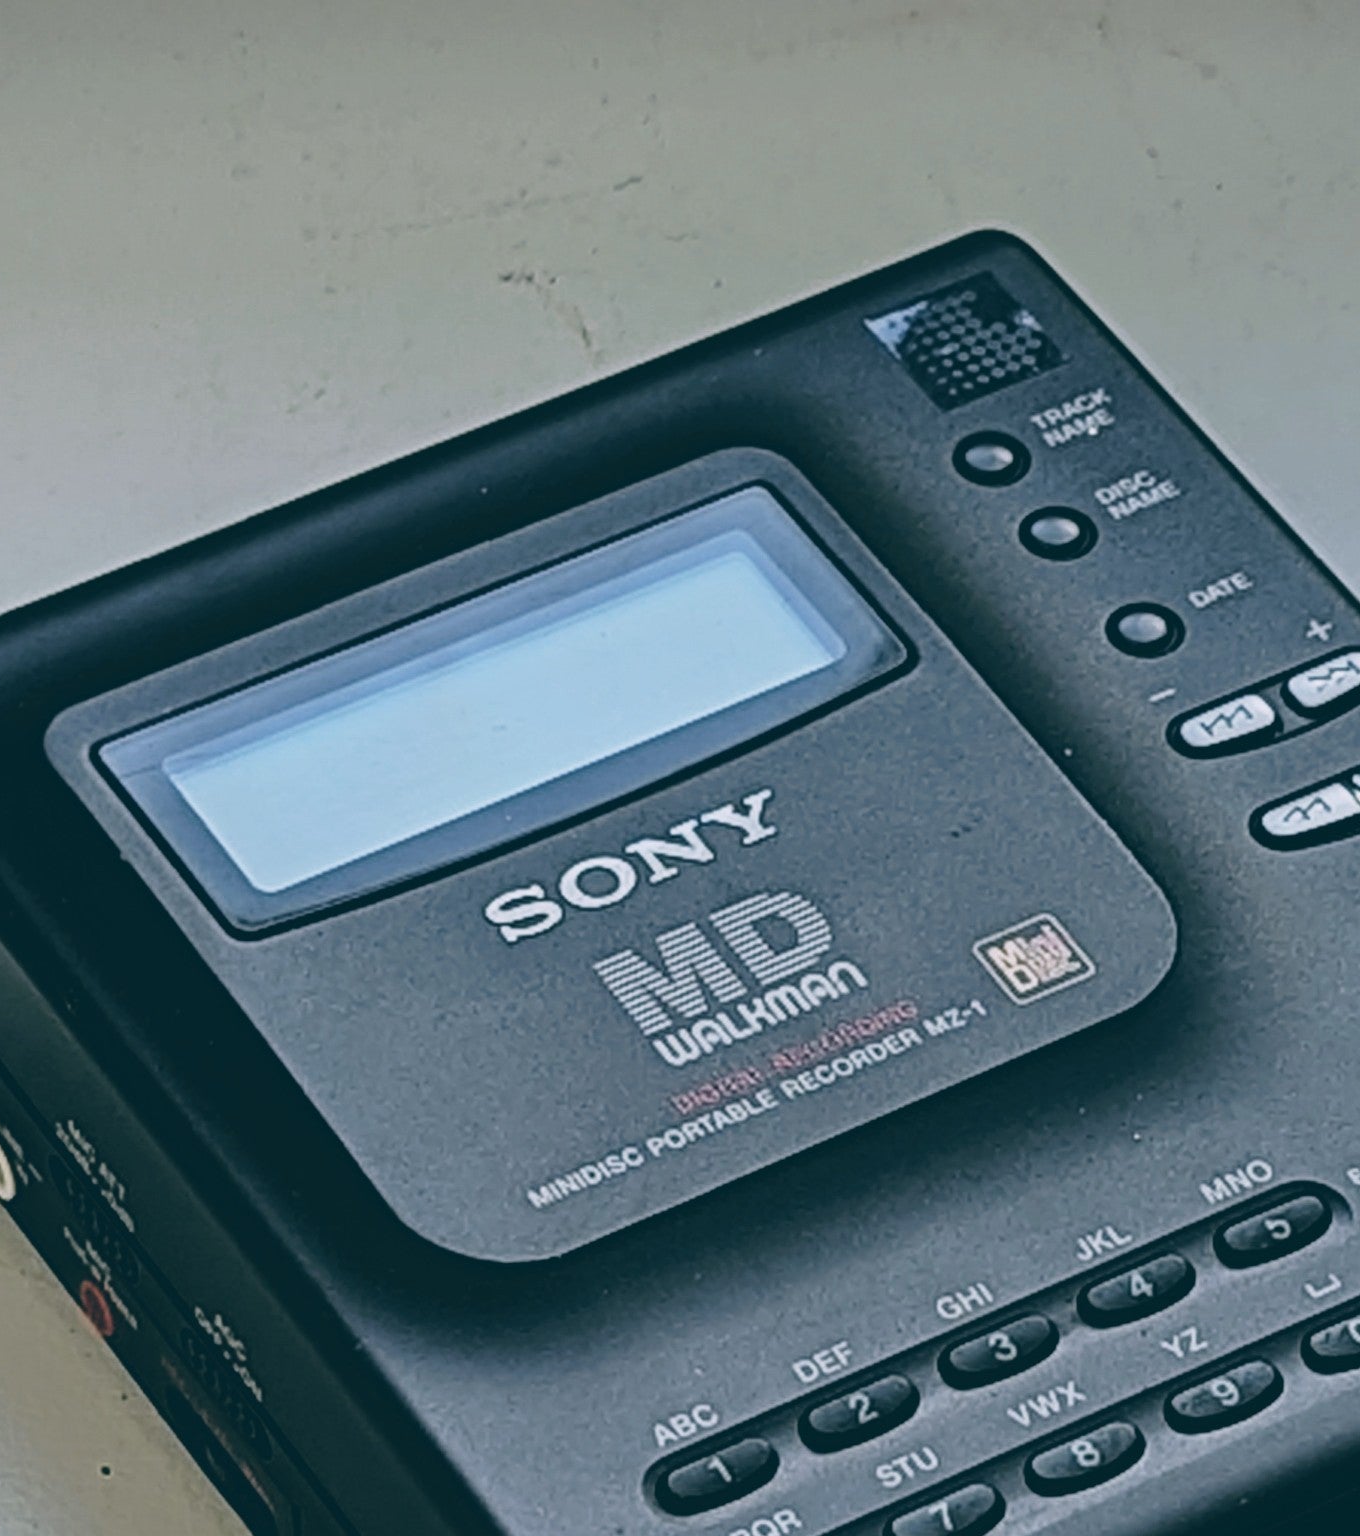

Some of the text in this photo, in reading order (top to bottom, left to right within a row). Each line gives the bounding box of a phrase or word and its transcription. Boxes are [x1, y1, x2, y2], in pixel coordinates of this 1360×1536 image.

[1030, 388, 1112, 429] TRACK
[1042, 409, 1115, 447] NAME
[1094, 469, 1156, 505] DISC
[1107, 479, 1181, 520] NAME
[1189, 571, 1253, 609] DATE
[484, 789, 777, 943] SONY
[593, 892, 832, 1035] MD
[653, 960, 869, 1067] WALKMAN
[528, 1000, 988, 1209] MINIDISC PORTABLE RECORDER MZ-1
[1198, 1159, 1274, 1205] MNO
[1076, 1224, 1133, 1262] JKL
[1265, 1217, 1292, 1241] 5
[936, 1283, 994, 1321] GHI
[1130, 1268, 1154, 1299] 4
[988, 1331, 1019, 1362] 3
[1160, 1326, 1208, 1361] YZ
[792, 1341, 855, 1385] DEF
[848, 1393, 879, 1424] 2
[1007, 1381, 1087, 1428] VWX
[1211, 1377, 1240, 1407] 9
[652, 1403, 720, 1448] ABC
[707, 1453, 733, 1484] 1
[875, 1447, 939, 1489] STU
[1071, 1438, 1101, 1469] 8
[928, 1501, 954, 1532] 7
